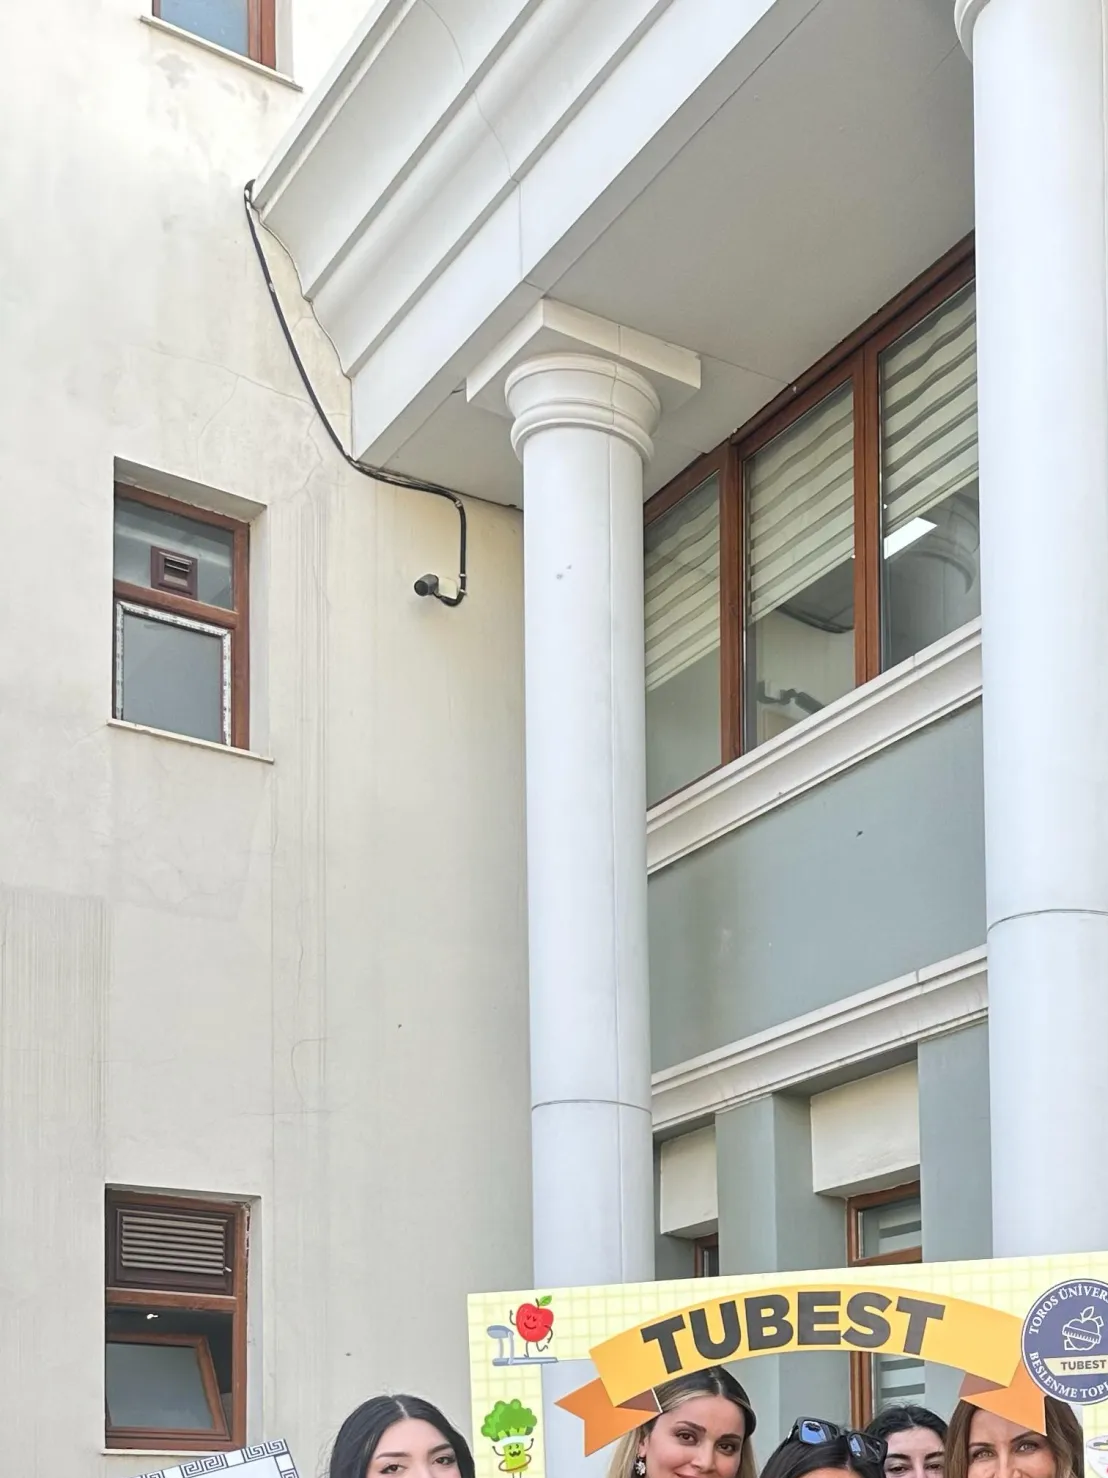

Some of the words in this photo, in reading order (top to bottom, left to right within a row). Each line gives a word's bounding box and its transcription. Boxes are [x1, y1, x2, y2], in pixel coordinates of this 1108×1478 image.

[640, 1291, 946, 1374] TUBEST
[1029, 1295, 1059, 1335] TOROS
[1029, 1351, 1078, 1398] BESLENME
[1060, 1359, 1107, 1371] TUBEST
